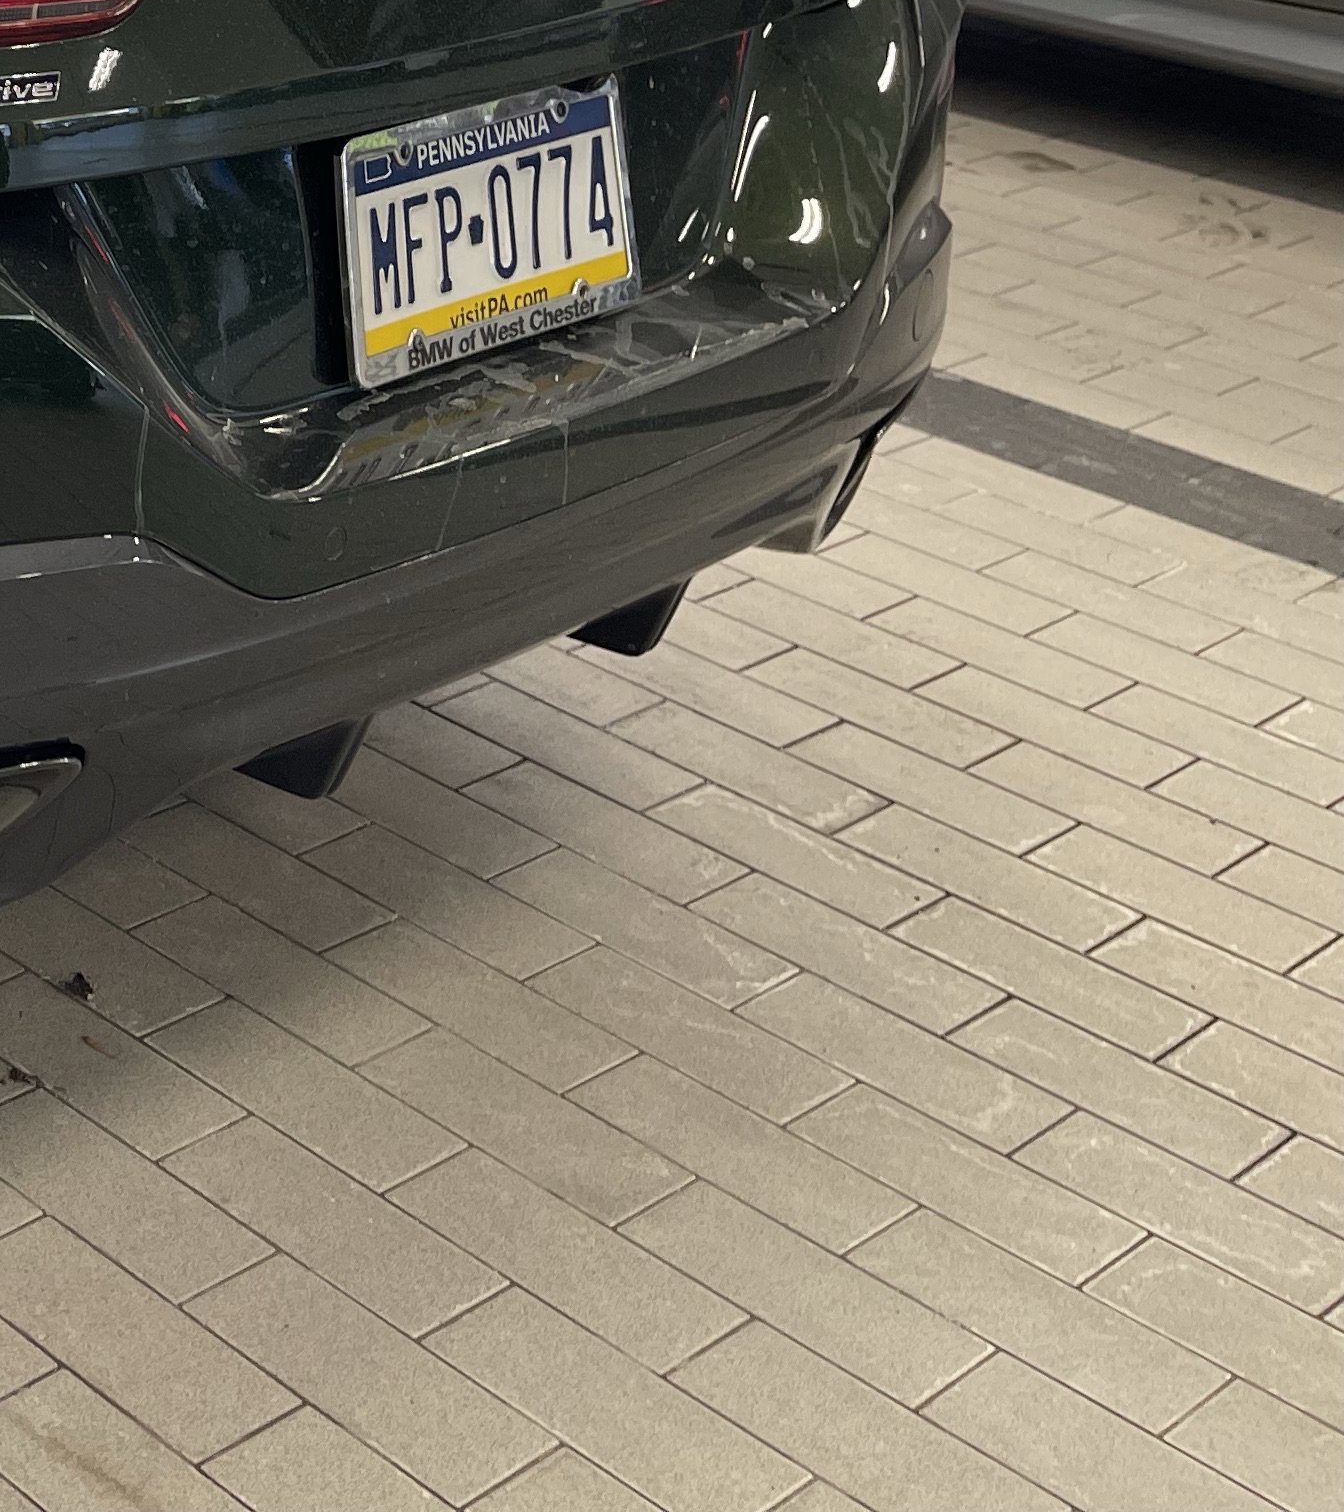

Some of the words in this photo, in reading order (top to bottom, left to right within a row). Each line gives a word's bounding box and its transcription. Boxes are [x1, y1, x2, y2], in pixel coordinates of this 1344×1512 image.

[417, 112, 550, 169] PENNSYLVANIA
[408, 334, 454, 371] BMW
[458, 329, 477, 354] of
[479, 317, 525, 352] West
[529, 294, 597, 332] Chester
[449, 286, 549, 330] visitPA.com
